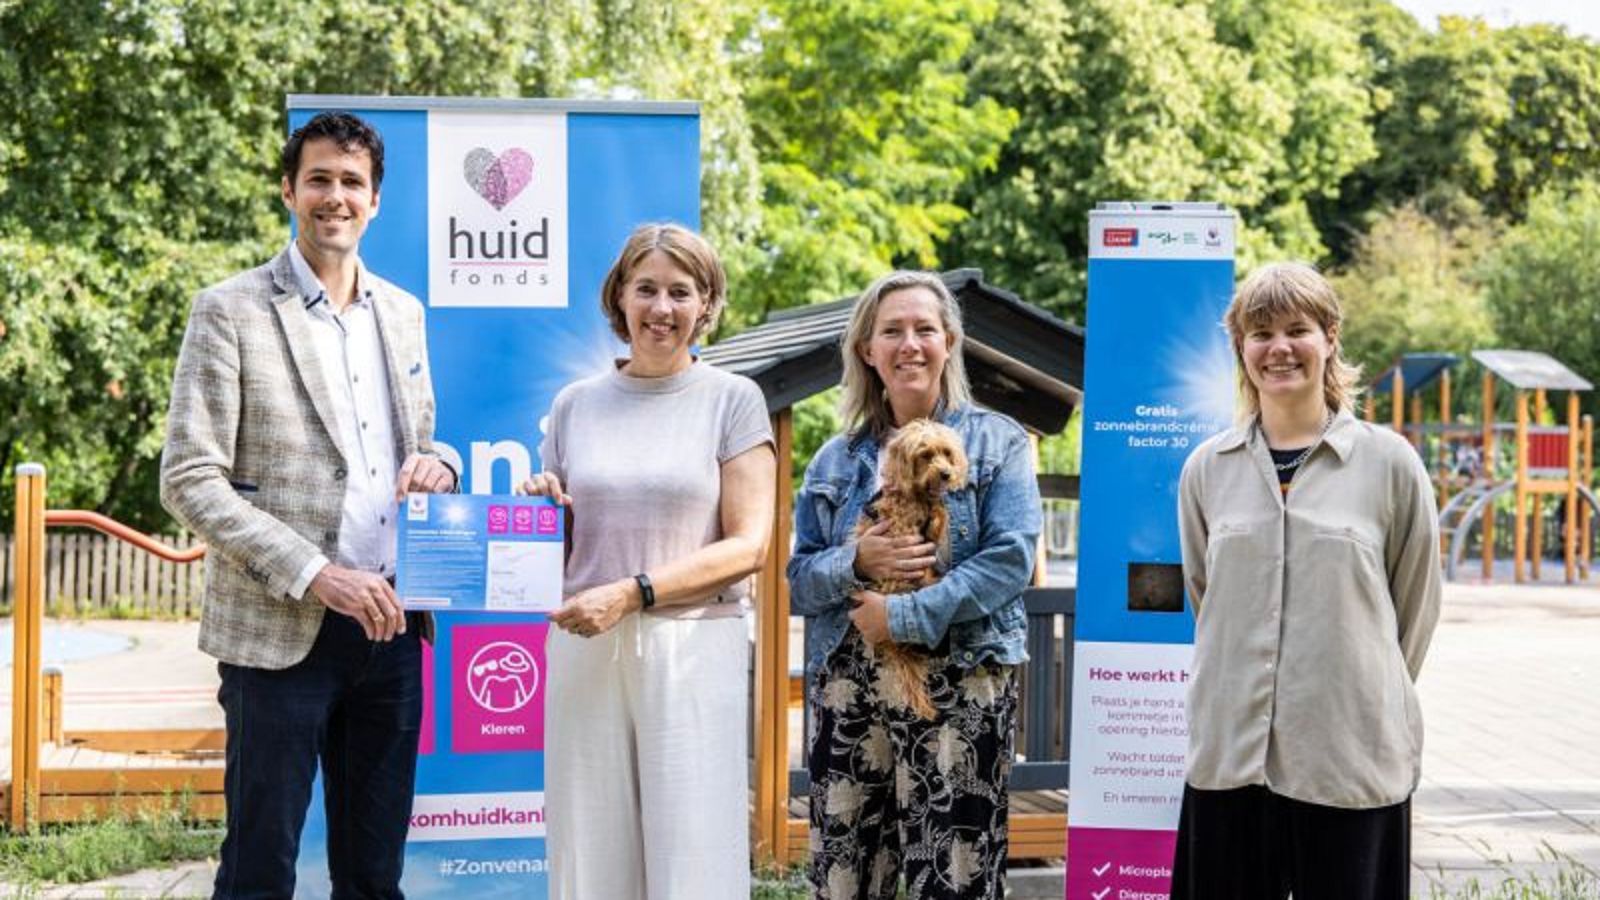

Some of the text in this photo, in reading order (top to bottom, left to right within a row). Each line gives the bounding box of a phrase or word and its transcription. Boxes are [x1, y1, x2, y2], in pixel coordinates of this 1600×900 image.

[449, 216, 548, 259] huid
[450, 269, 549, 286] fonds
[1135, 404, 1180, 417] Gratis
[1128, 436, 1189, 448] factor 30
[1089, 668, 1123, 681] Hoe
[1128, 670, 1175, 682] werkt
[1091, 695, 1127, 707] Plaats
[1144, 697, 1174, 708] hand
[481, 724, 525, 736] Kleren
[1098, 725, 1148, 738] opening
[1107, 752, 1146, 763] Wacht
[1093, 766, 1164, 777] zonnebrand
[408, 808, 545, 828] omhuidkan
